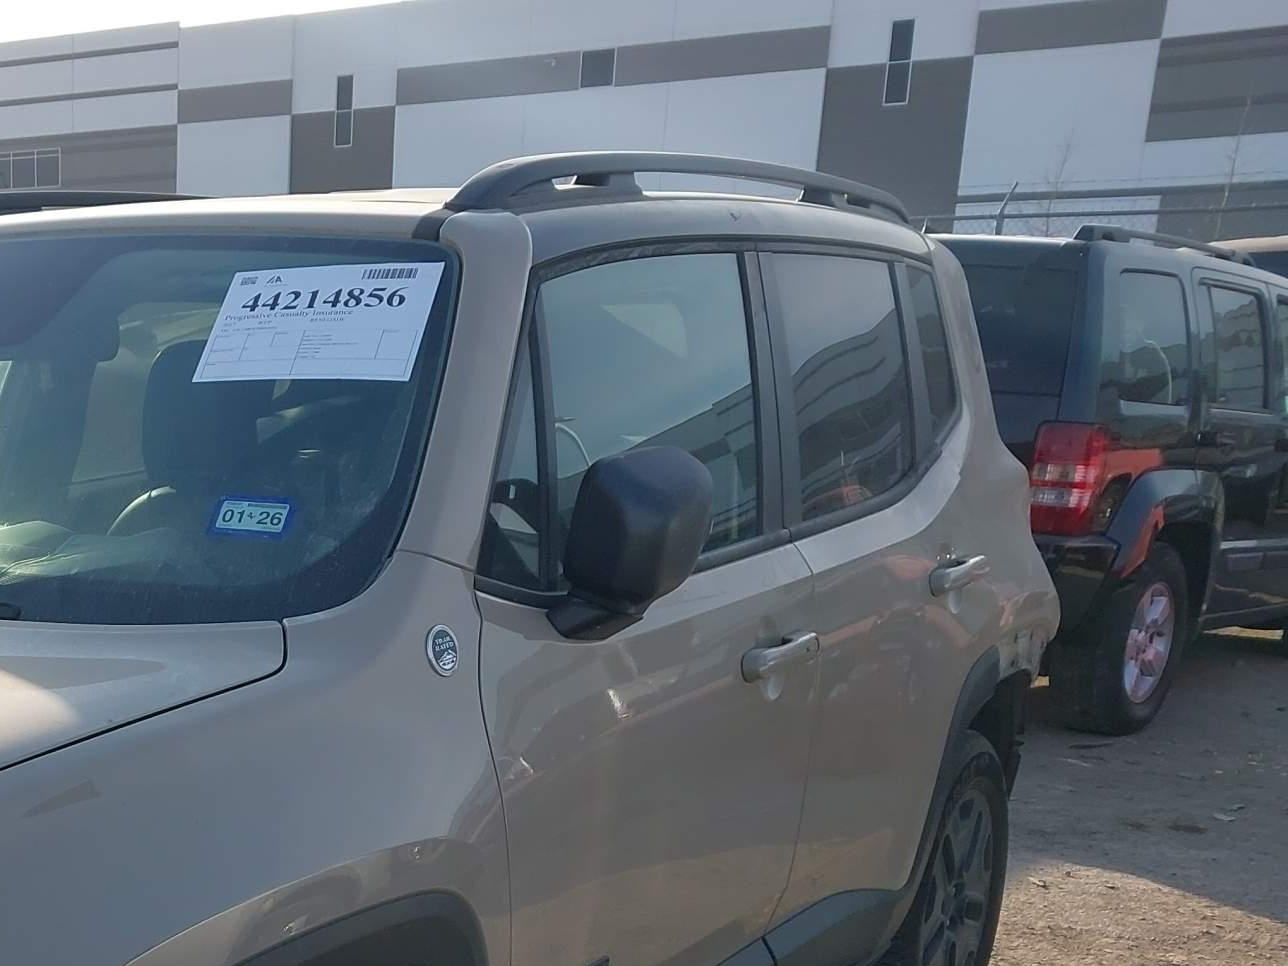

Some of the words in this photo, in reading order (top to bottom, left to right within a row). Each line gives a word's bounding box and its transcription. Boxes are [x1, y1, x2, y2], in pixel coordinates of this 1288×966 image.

[241, 286, 409, 312] 44214856
[224, 311, 271, 321] Progressive
[273, 310, 309, 319] Casualty
[312, 308, 354, 317] Insurance
[222, 509, 245, 523] 01
[256, 511, 283, 526] 26
